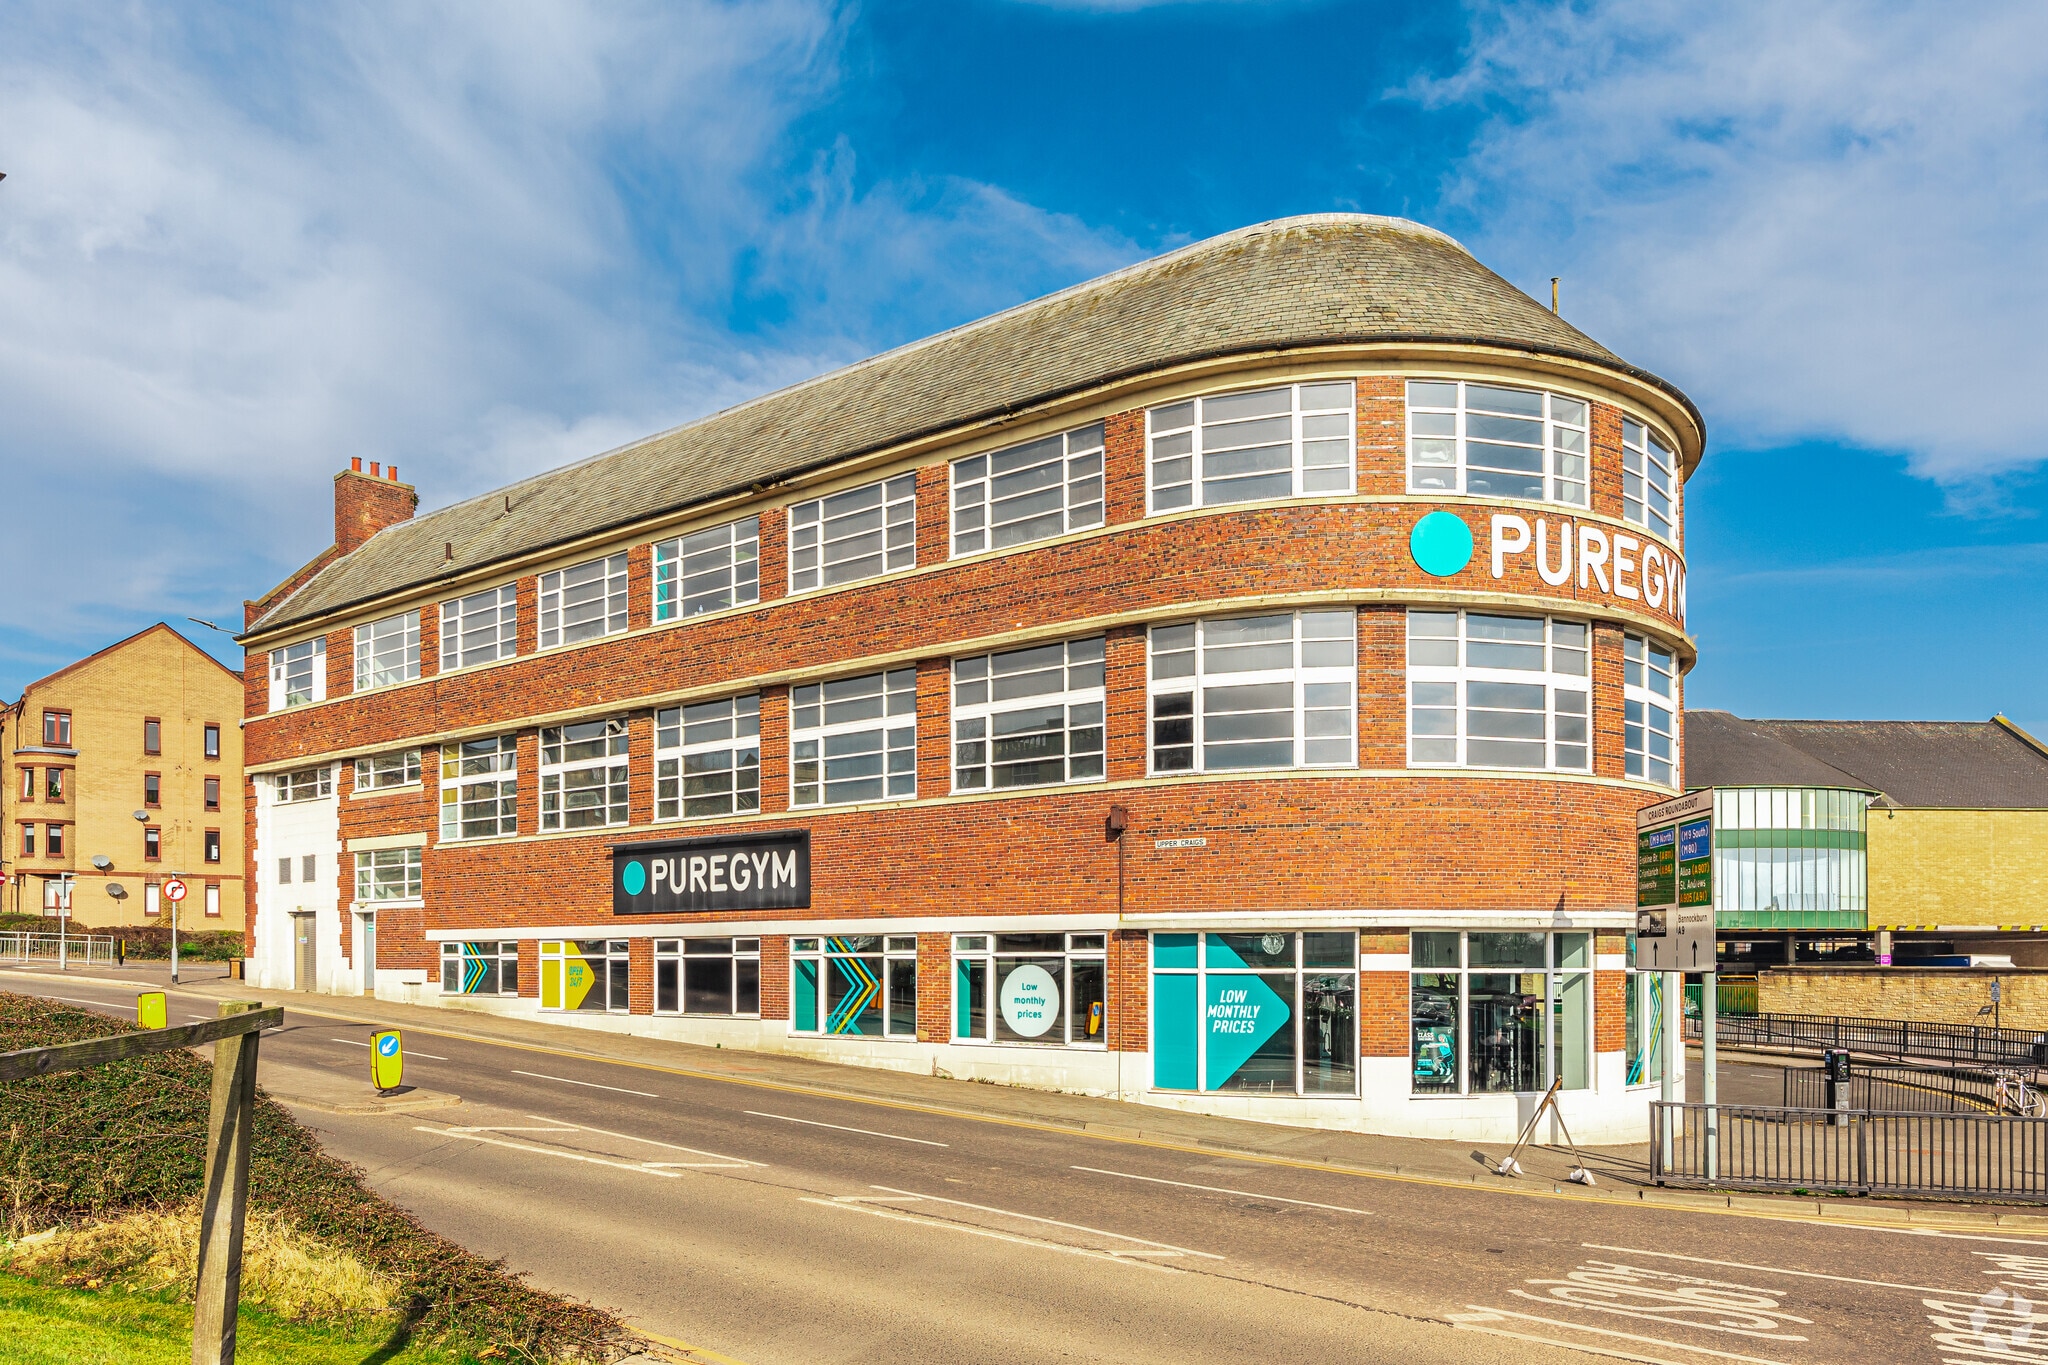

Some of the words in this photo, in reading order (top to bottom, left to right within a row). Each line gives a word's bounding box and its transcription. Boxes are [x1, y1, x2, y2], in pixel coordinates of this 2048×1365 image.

[1490, 514, 1687, 630] PUREGYM
[1648, 808, 1665, 820] CRAIGS
[1666, 798, 1698, 814] ROUNDABOUT
[1692, 825, 1709, 838] South)
[1660, 831, 1674, 843] North)
[651, 849, 796, 895] PUREGYM
[1639, 881, 1657, 891] University
[1687, 879, 1706, 889] Andrews
[1678, 914, 1708, 924] Bannockburn
[1678, 926, 1685, 935] A9
[568, 966, 584, 975] OPEN
[569, 977, 582, 987] 24/7
[1021, 982, 1038, 991] Low
[1014, 997, 1046, 1006] monthly
[1220, 990, 1247, 1003] LOW
[1017, 1009, 1042, 1019] prices
[1207, 1005, 1260, 1019] MONTHLY
[1212, 1020, 1255, 1033] PRICES
